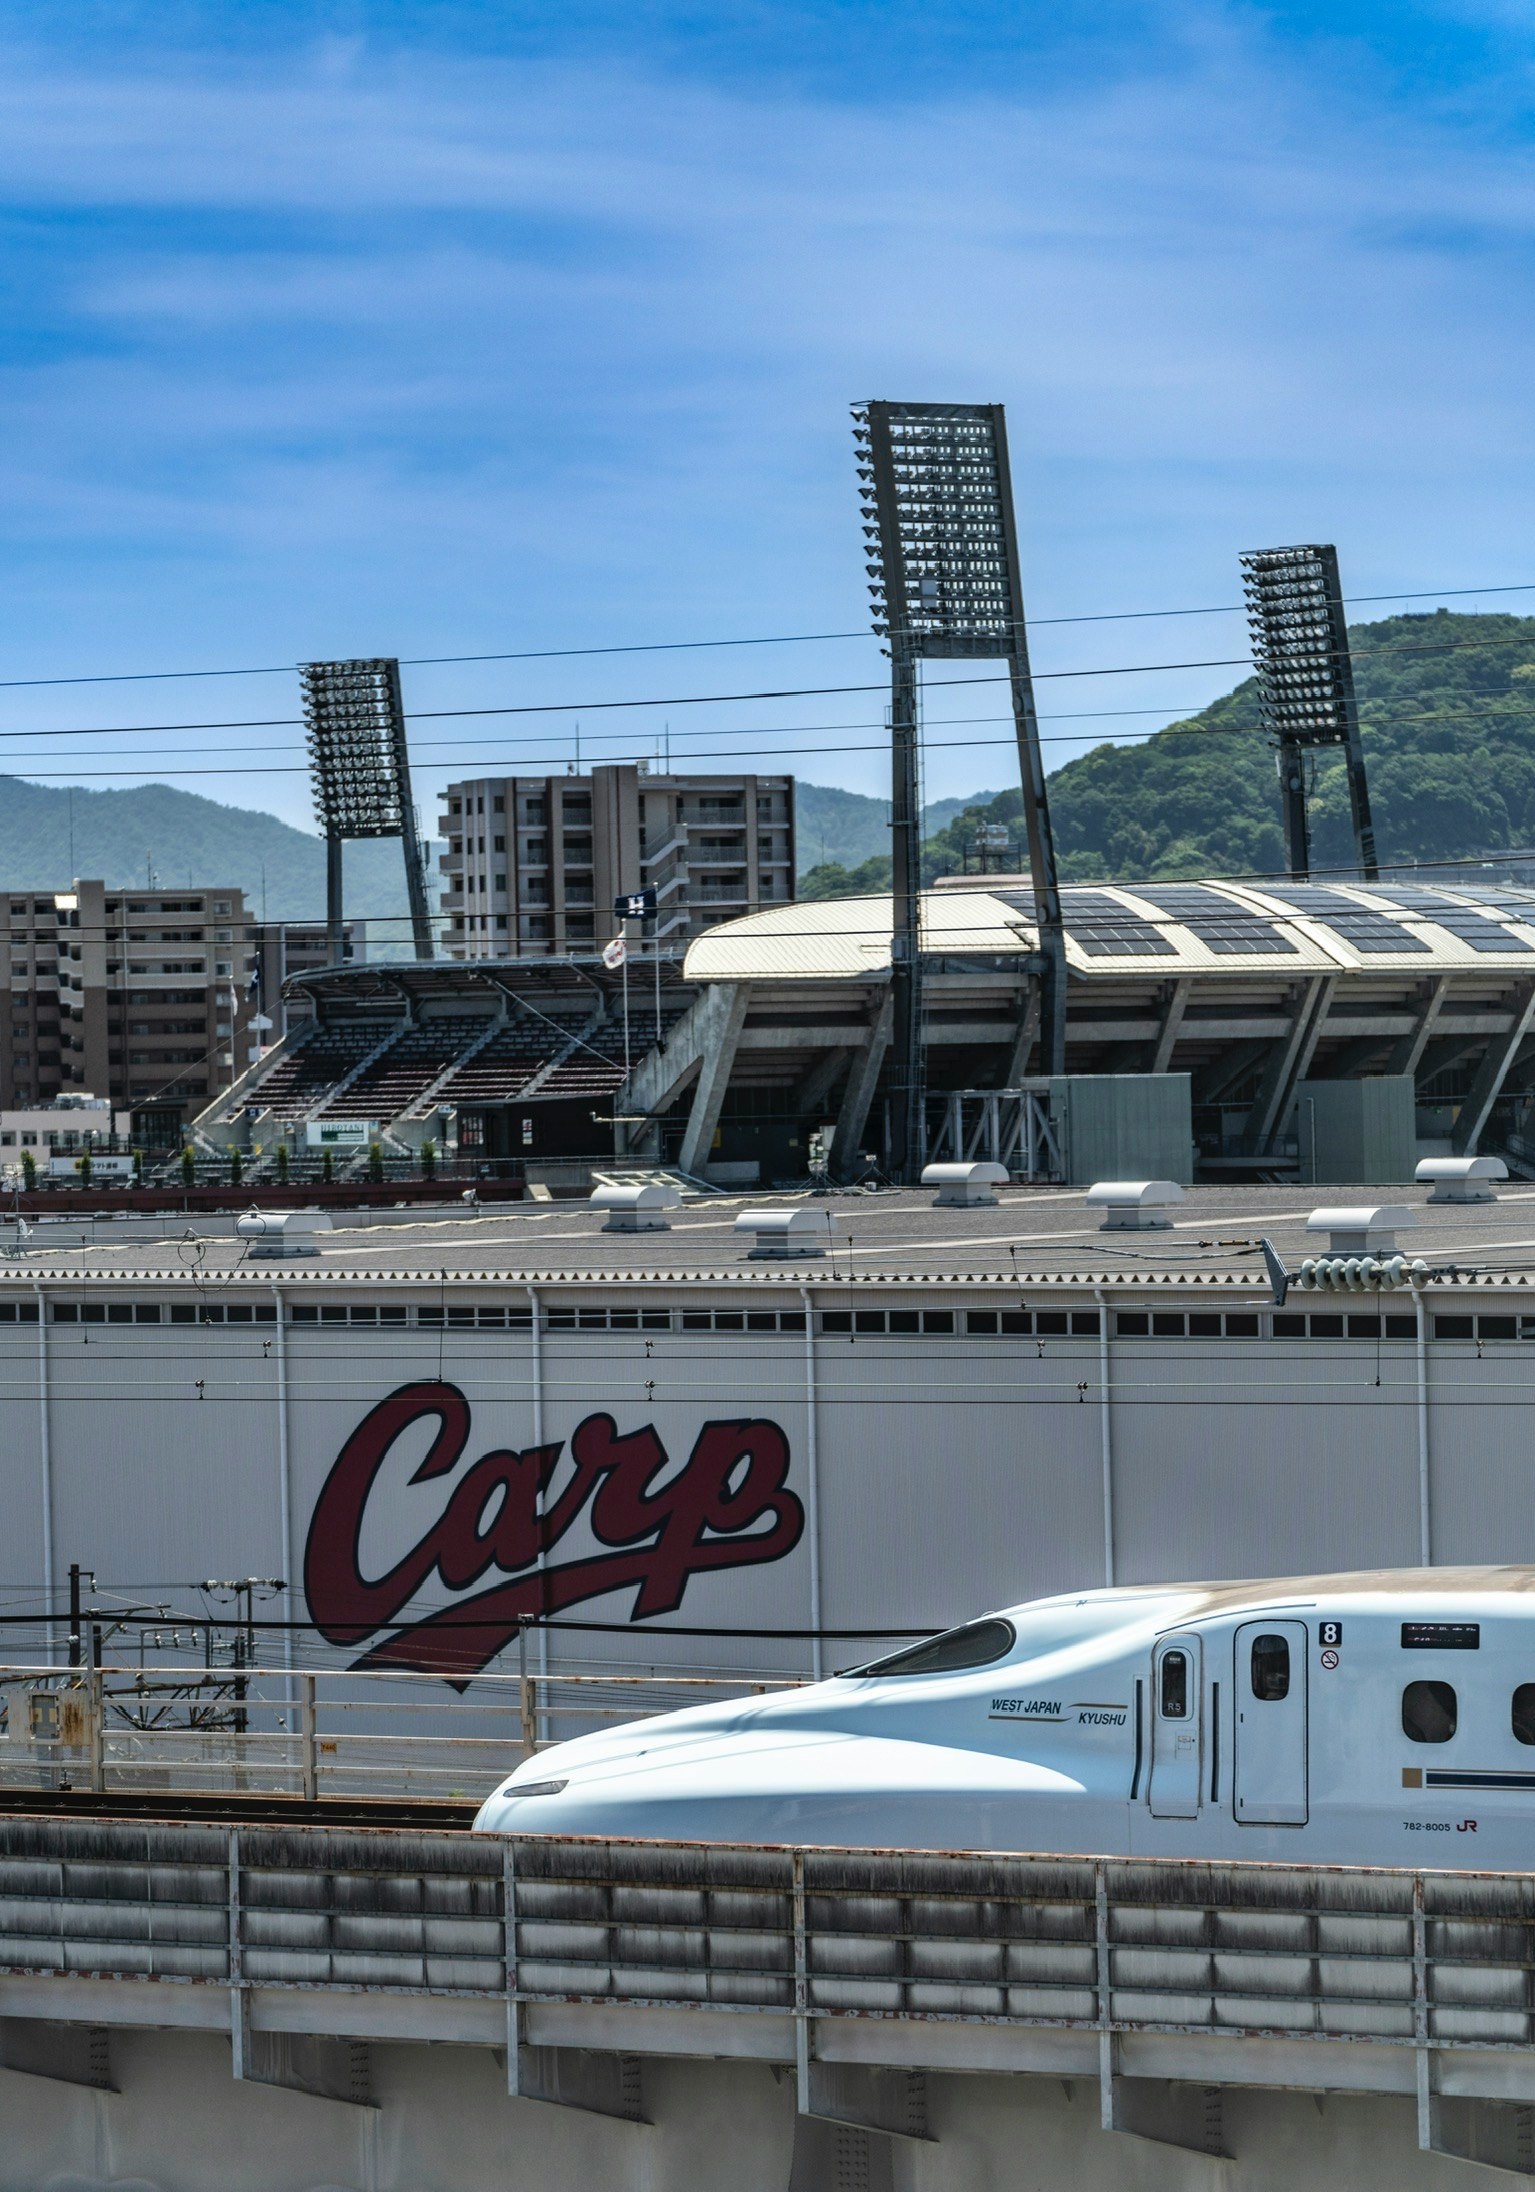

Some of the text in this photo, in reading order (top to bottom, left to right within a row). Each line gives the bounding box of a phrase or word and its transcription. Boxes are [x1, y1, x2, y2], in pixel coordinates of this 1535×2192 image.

[303, 1378, 805, 1694] Carp
[1324, 1623, 1337, 1643] 8
[991, 1699, 1062, 1714] WEST JAPAN
[1078, 1712, 1126, 1726] KYUSHU
[1403, 1820, 1477, 1832] 782-8005 JR
